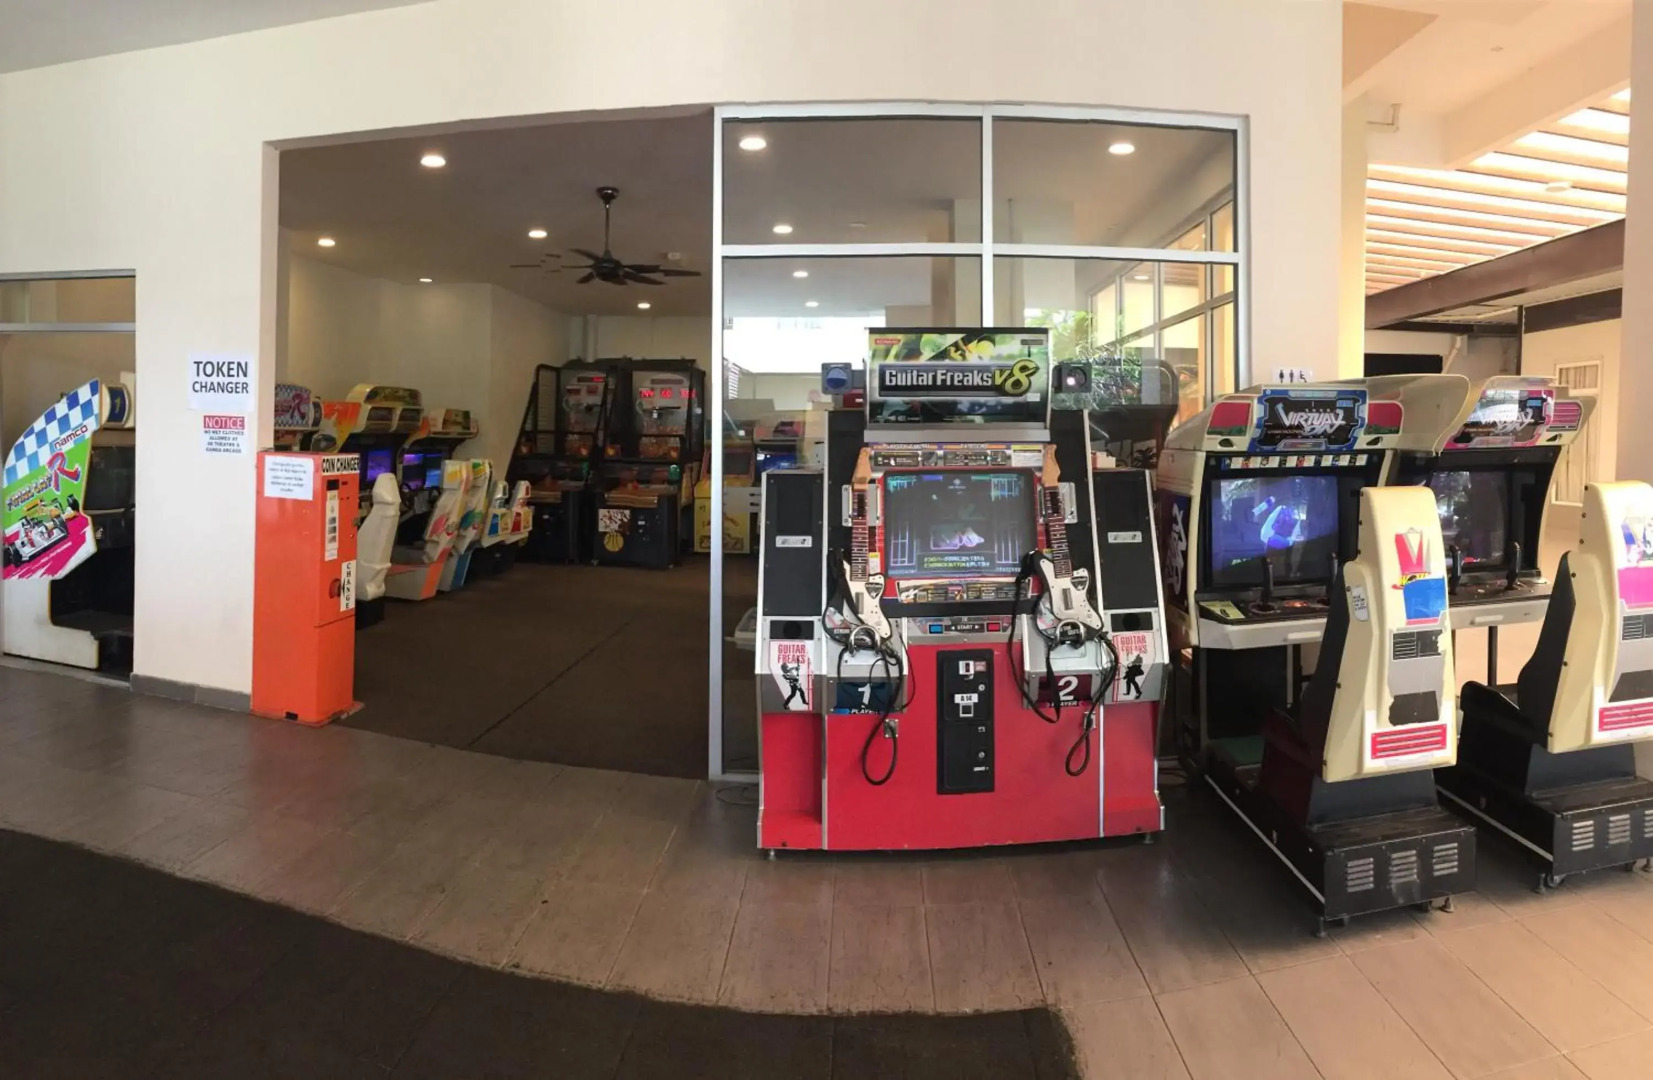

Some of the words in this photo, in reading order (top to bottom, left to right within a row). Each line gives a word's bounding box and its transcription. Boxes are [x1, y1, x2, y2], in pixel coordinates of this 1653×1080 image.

[193, 361, 248, 378] TOKEN
[192, 381, 249, 394] CHANGER
[205, 417, 243, 429] NOTICE
[54, 424, 88, 449] namco
[322, 458, 336, 473] COIN
[1120, 635, 1147, 645] GUITAR
[778, 644, 806, 654] GUITAR
[778, 654, 806, 664] FREAKS
[1058, 675, 1078, 700] 2
[858, 683, 871, 707] 1
